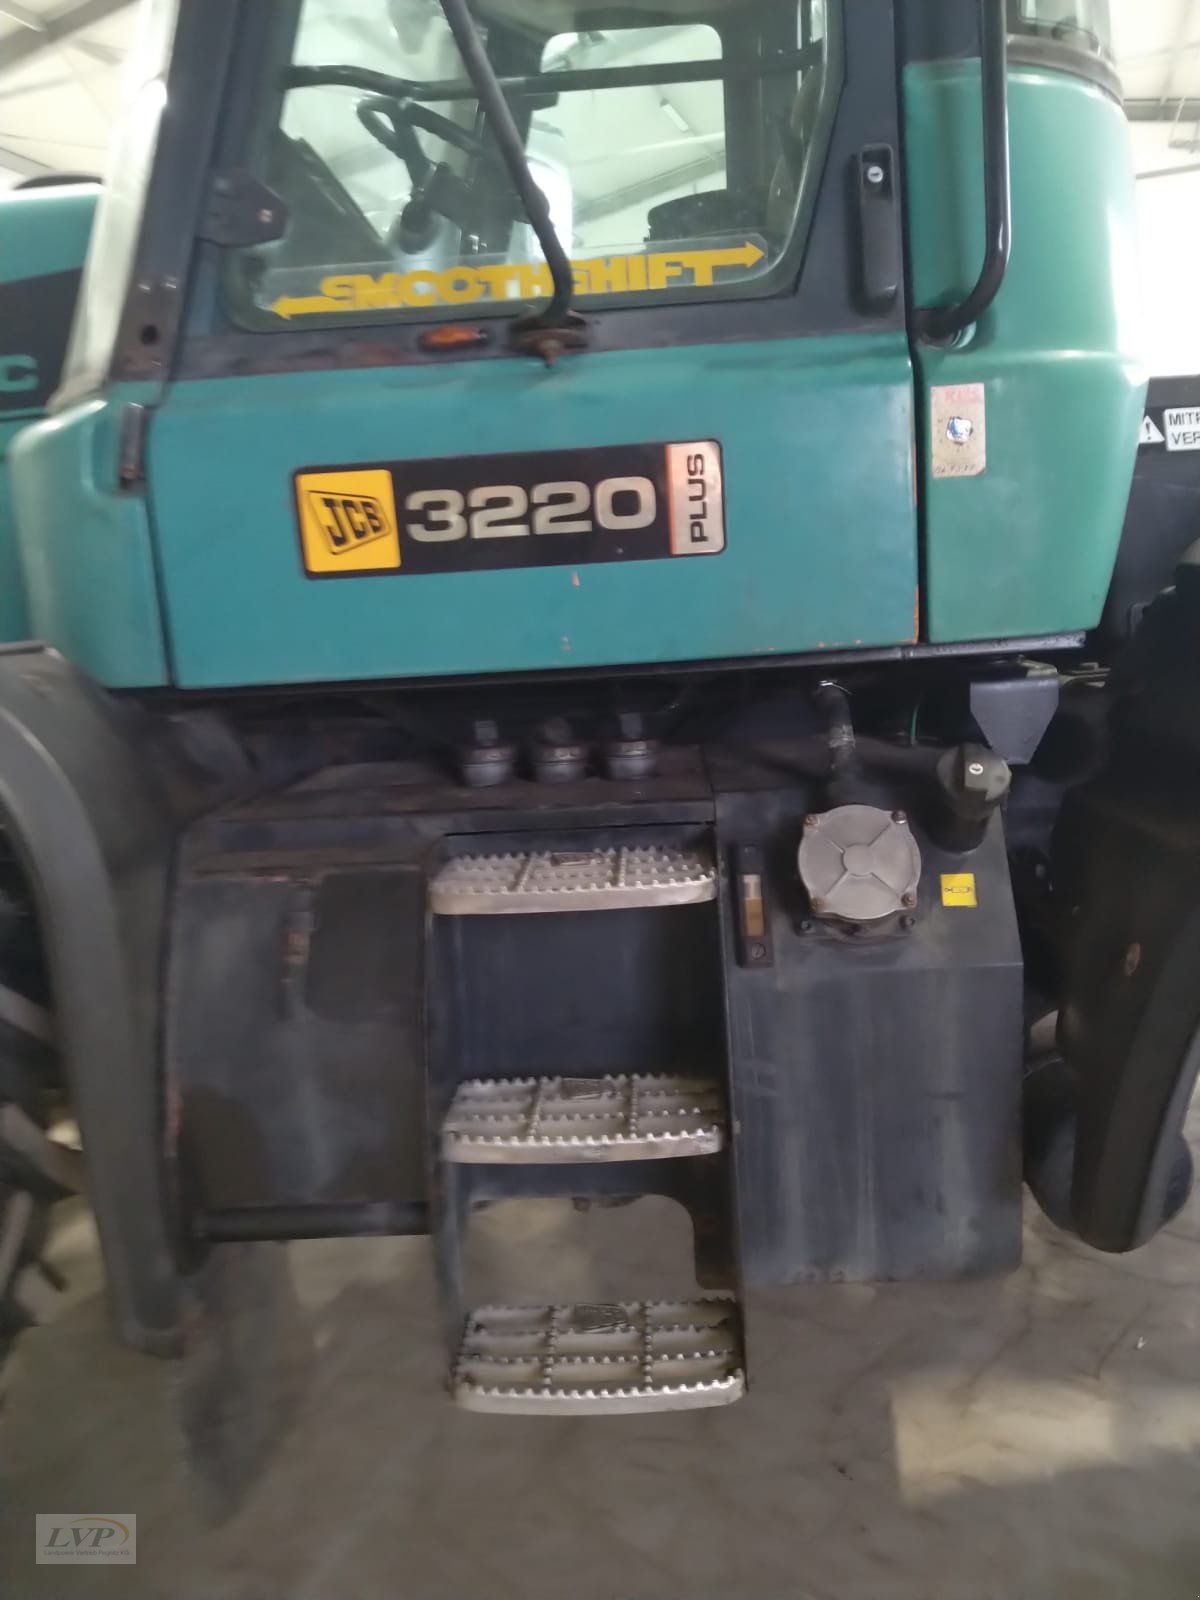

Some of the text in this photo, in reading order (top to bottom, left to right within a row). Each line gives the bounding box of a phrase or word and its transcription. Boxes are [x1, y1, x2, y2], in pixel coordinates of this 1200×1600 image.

[320, 497, 384, 547] JCB
[405, 475, 657, 543] 3220
[686, 453, 709, 543] PLUS
